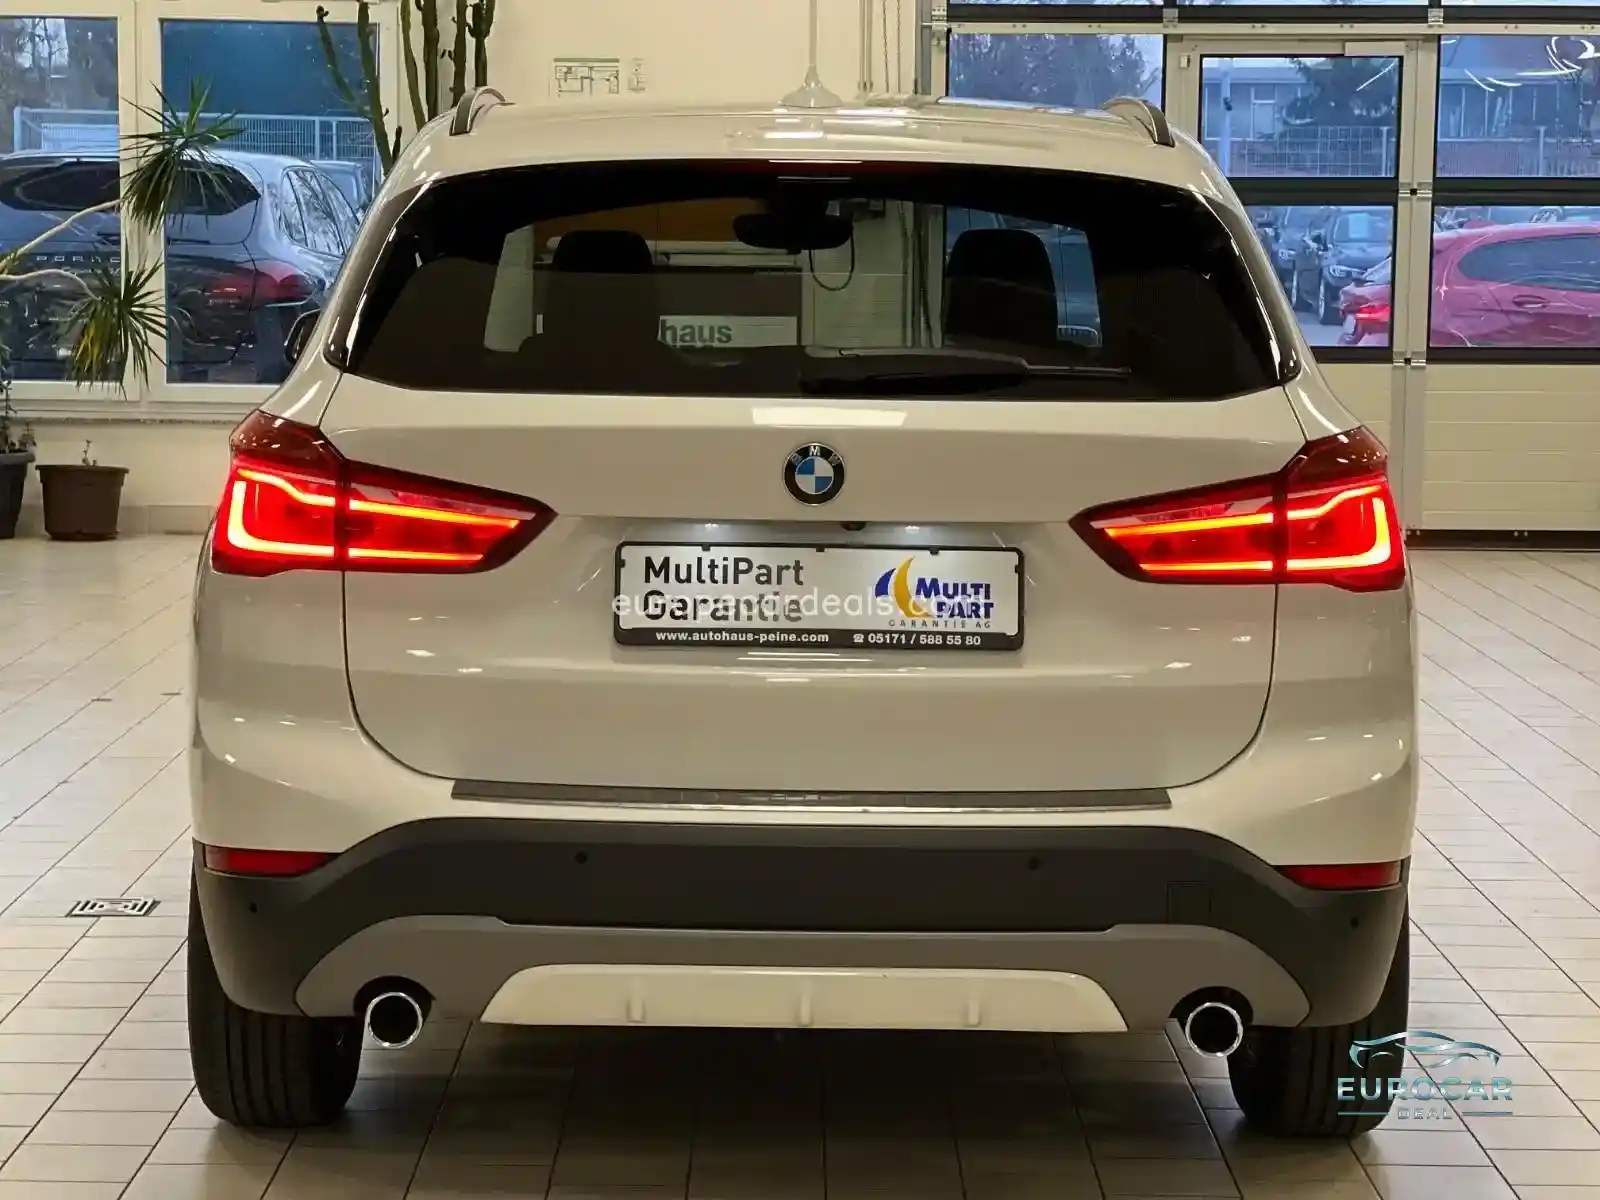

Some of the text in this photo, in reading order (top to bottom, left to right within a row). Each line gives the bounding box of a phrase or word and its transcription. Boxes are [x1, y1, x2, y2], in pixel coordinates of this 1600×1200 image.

[660, 319, 732, 343] haus
[644, 556, 804, 586] MultiPart
[915, 577, 991, 600] MULTI
[643, 589, 802, 622] Garantie
[936, 602, 994, 619] PART
[888, 619, 991, 629] GARANTIE AG
[655, 631, 829, 644] www.autohaus-peine.com
[867, 633, 906, 645] 05171
[919, 634, 943, 646] 588
[946, 635, 962, 646] 55
[965, 635, 982, 646] 80
